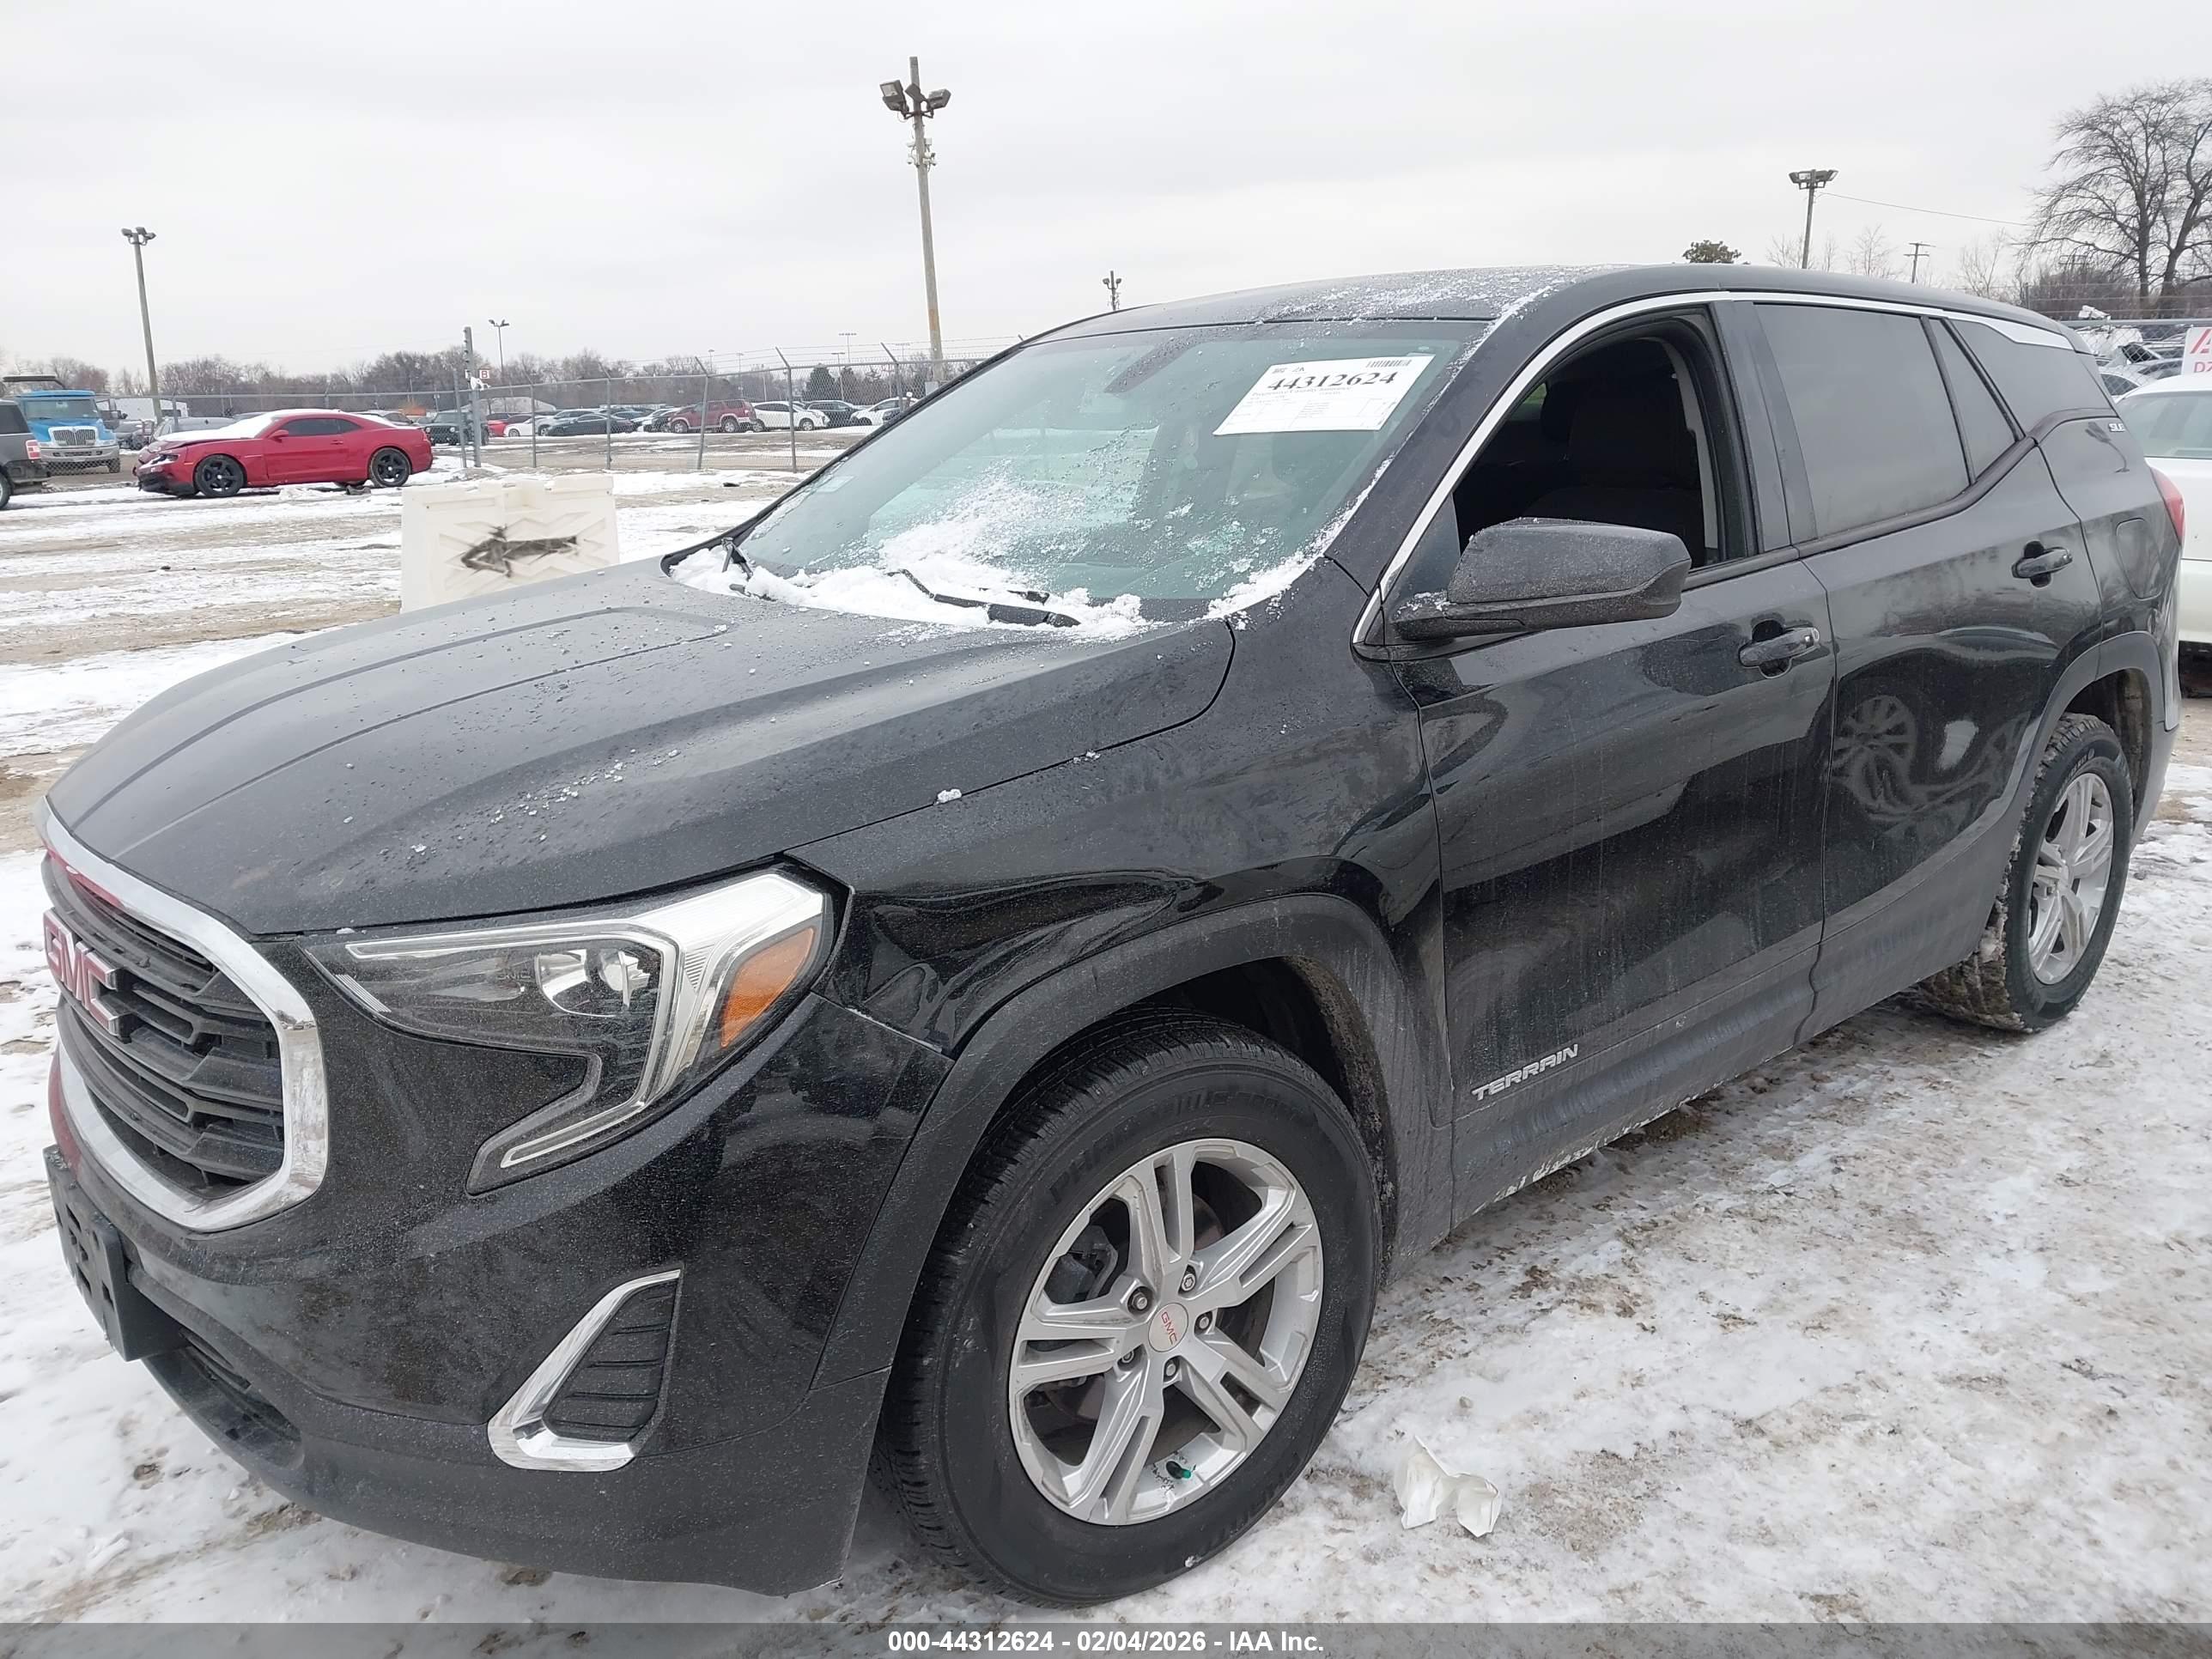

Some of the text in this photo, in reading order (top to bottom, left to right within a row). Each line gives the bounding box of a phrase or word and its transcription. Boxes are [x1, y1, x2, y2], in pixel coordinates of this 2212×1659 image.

[1267, 371, 1399, 391] 44312624
[43, 907, 131, 1042] GMC
[1471, 1043, 1579, 1102] TERRAIN
[1161, 1311, 1177, 1346] GMC
